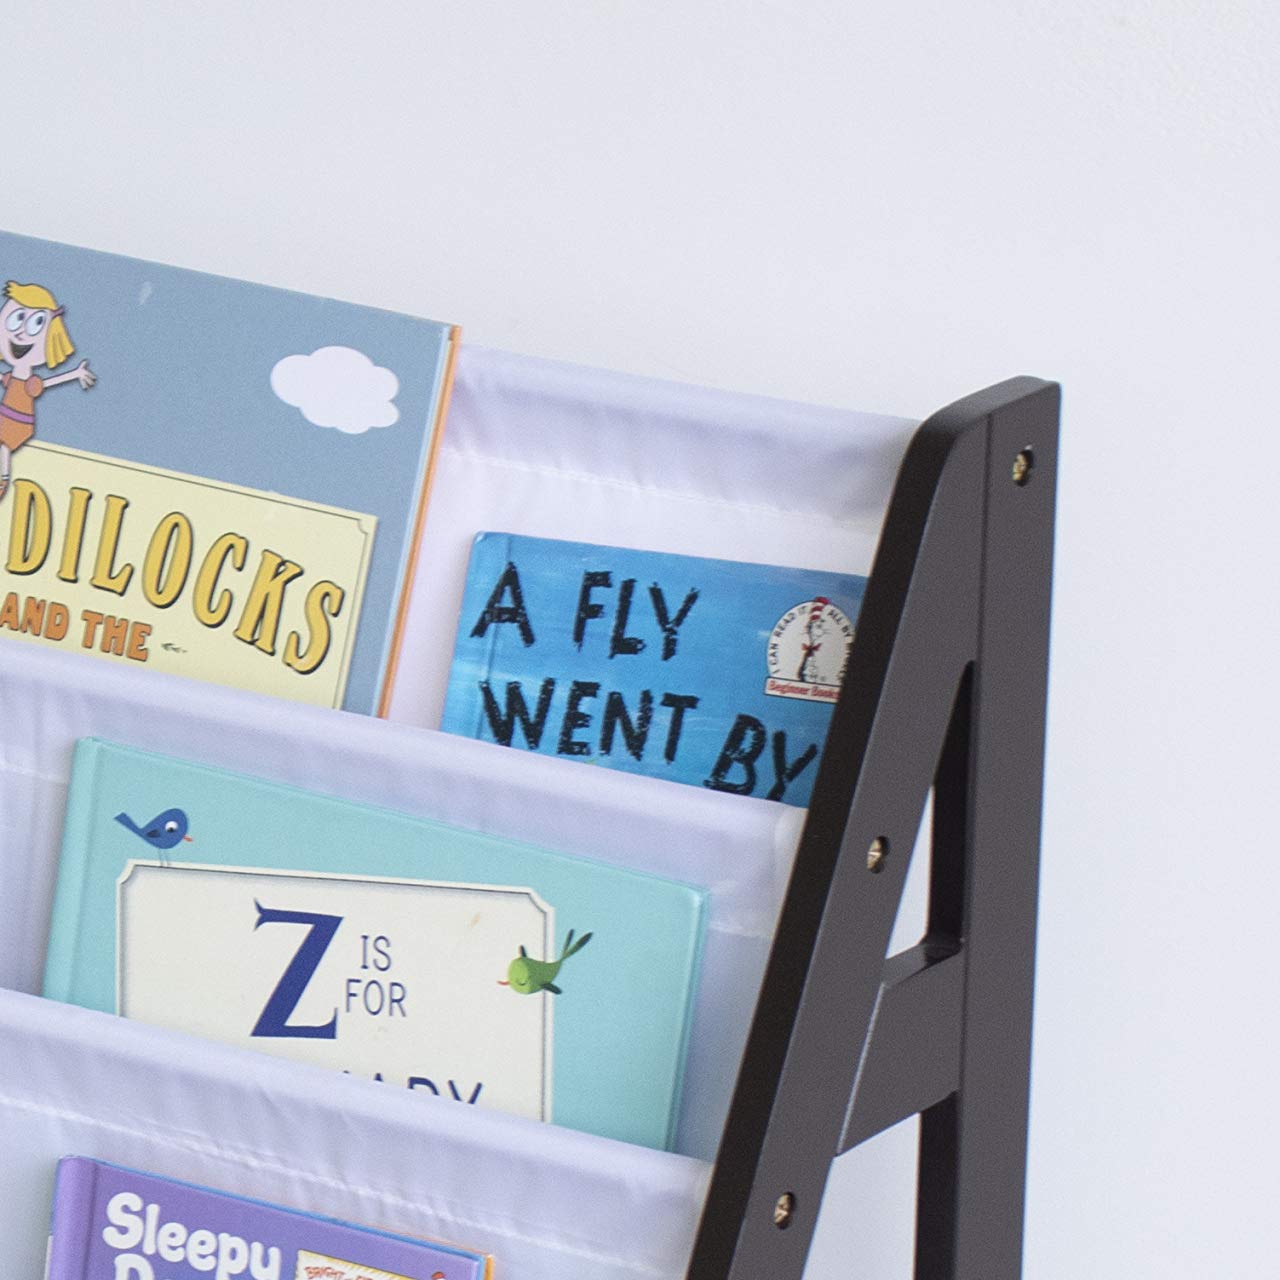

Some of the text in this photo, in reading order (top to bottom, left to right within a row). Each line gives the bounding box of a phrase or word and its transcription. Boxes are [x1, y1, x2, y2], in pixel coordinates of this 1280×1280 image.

[81, 609, 152, 661] THE
[470, 561, 700, 661] A FLY
[479, 677, 818, 801] WENT BY
[251, 899, 392, 1039] Z IS
[345, 978, 407, 1018] FOR
